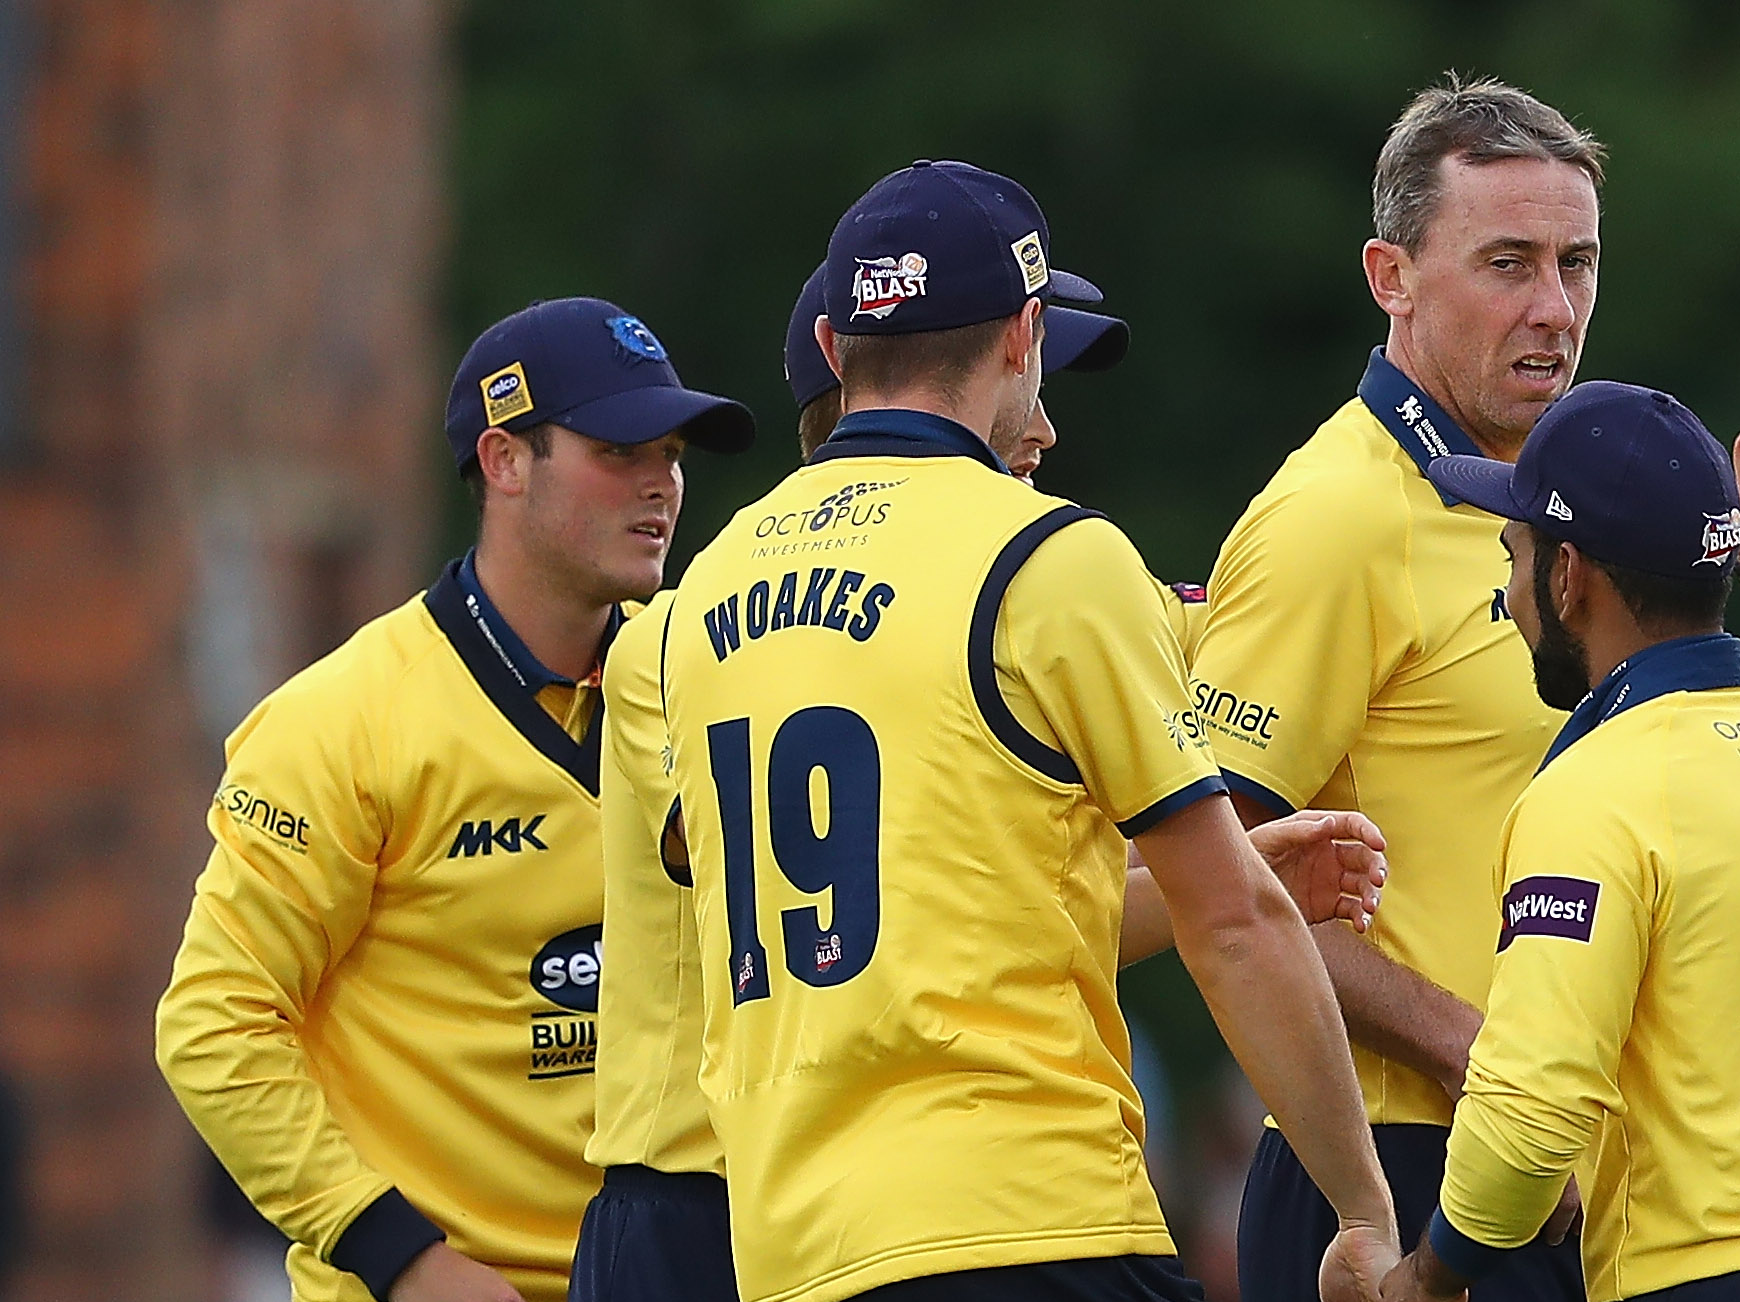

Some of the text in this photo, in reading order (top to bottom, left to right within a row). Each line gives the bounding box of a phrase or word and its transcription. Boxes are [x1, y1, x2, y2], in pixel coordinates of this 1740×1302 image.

[861, 276, 927, 302] BLAST
[489, 376, 519, 398] selco
[756, 503, 891, 538] OCTOPUS
[751, 535, 868, 560] INVESTMENTS
[704, 567, 896, 664] WOAKES
[706, 705, 881, 1010] 19
[816, 947, 842, 965] BLAST
